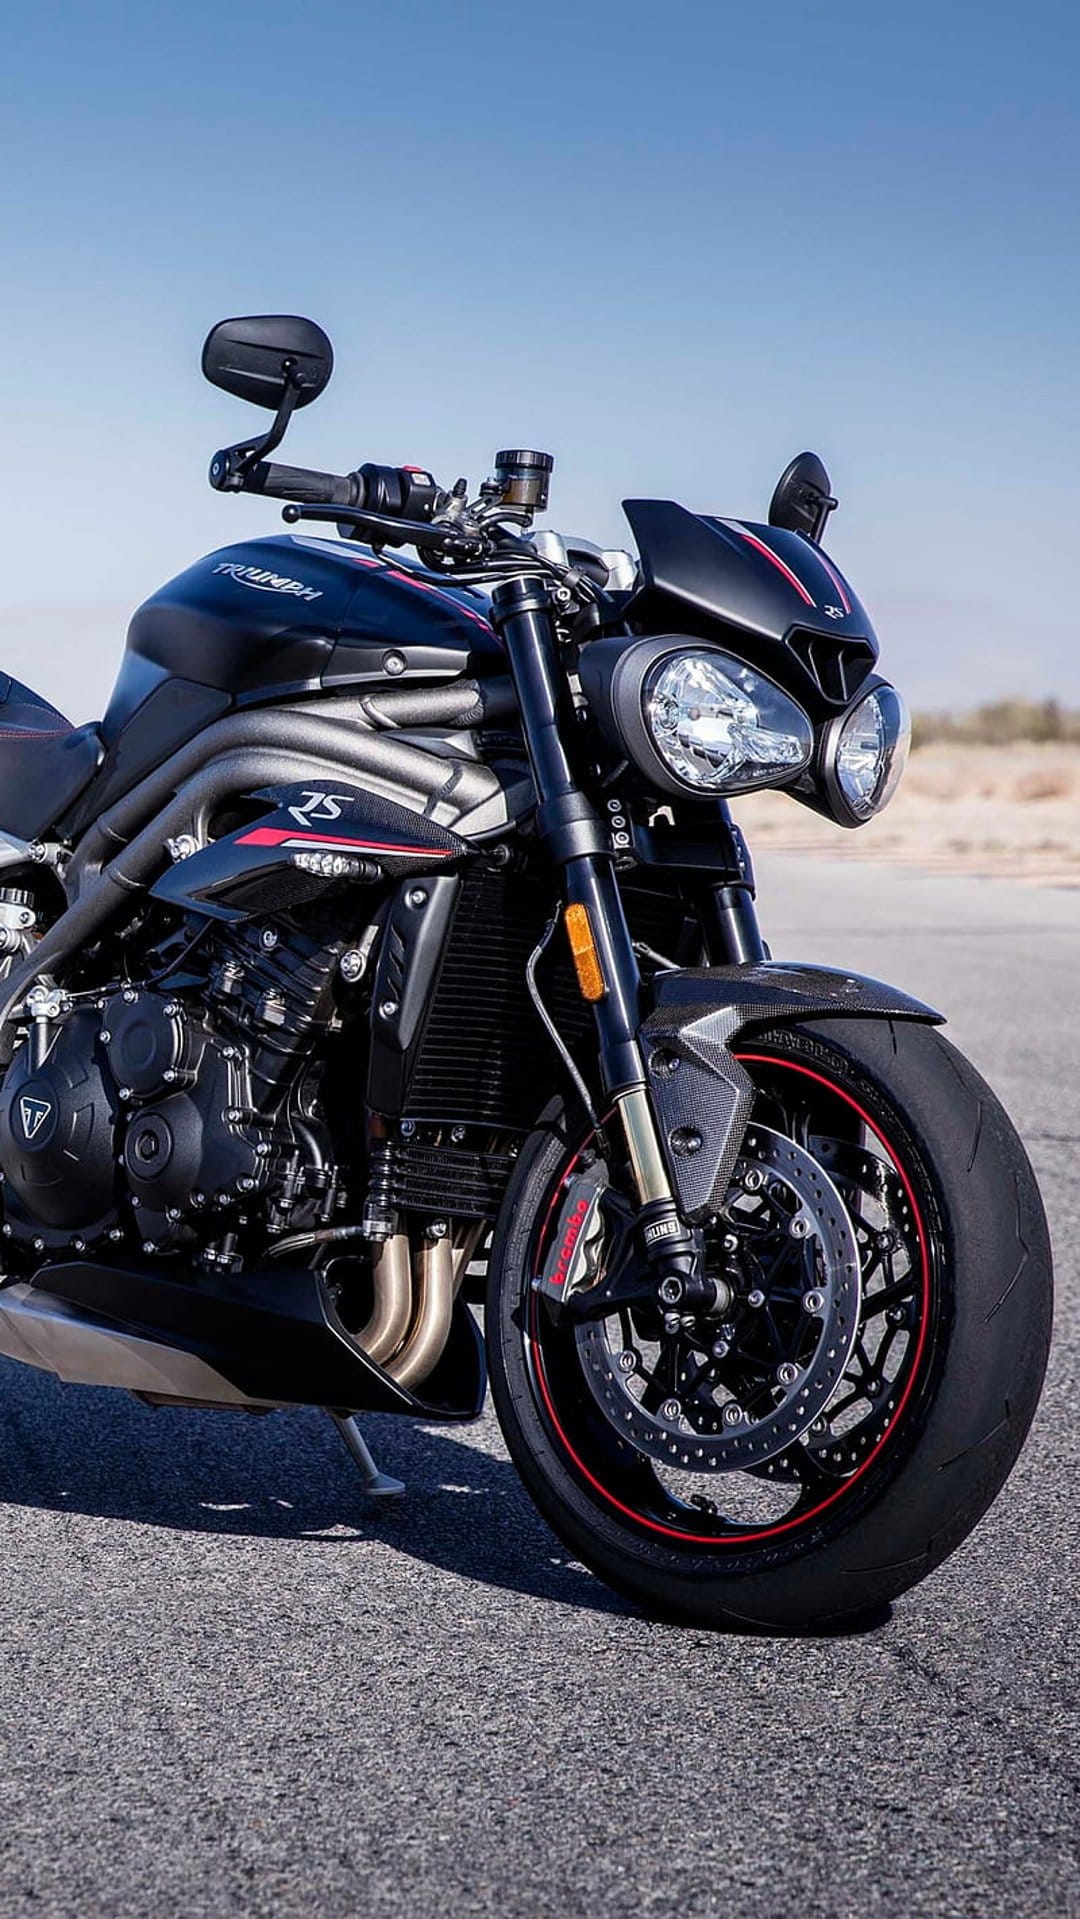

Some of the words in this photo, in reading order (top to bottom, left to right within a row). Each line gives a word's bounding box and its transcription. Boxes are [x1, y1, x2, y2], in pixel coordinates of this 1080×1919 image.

[211, 563, 323, 601] TRIUMPH
[287, 791, 355, 827] RS
[549, 1200, 588, 1285] brembo
[645, 1221, 677, 1243] LINS
